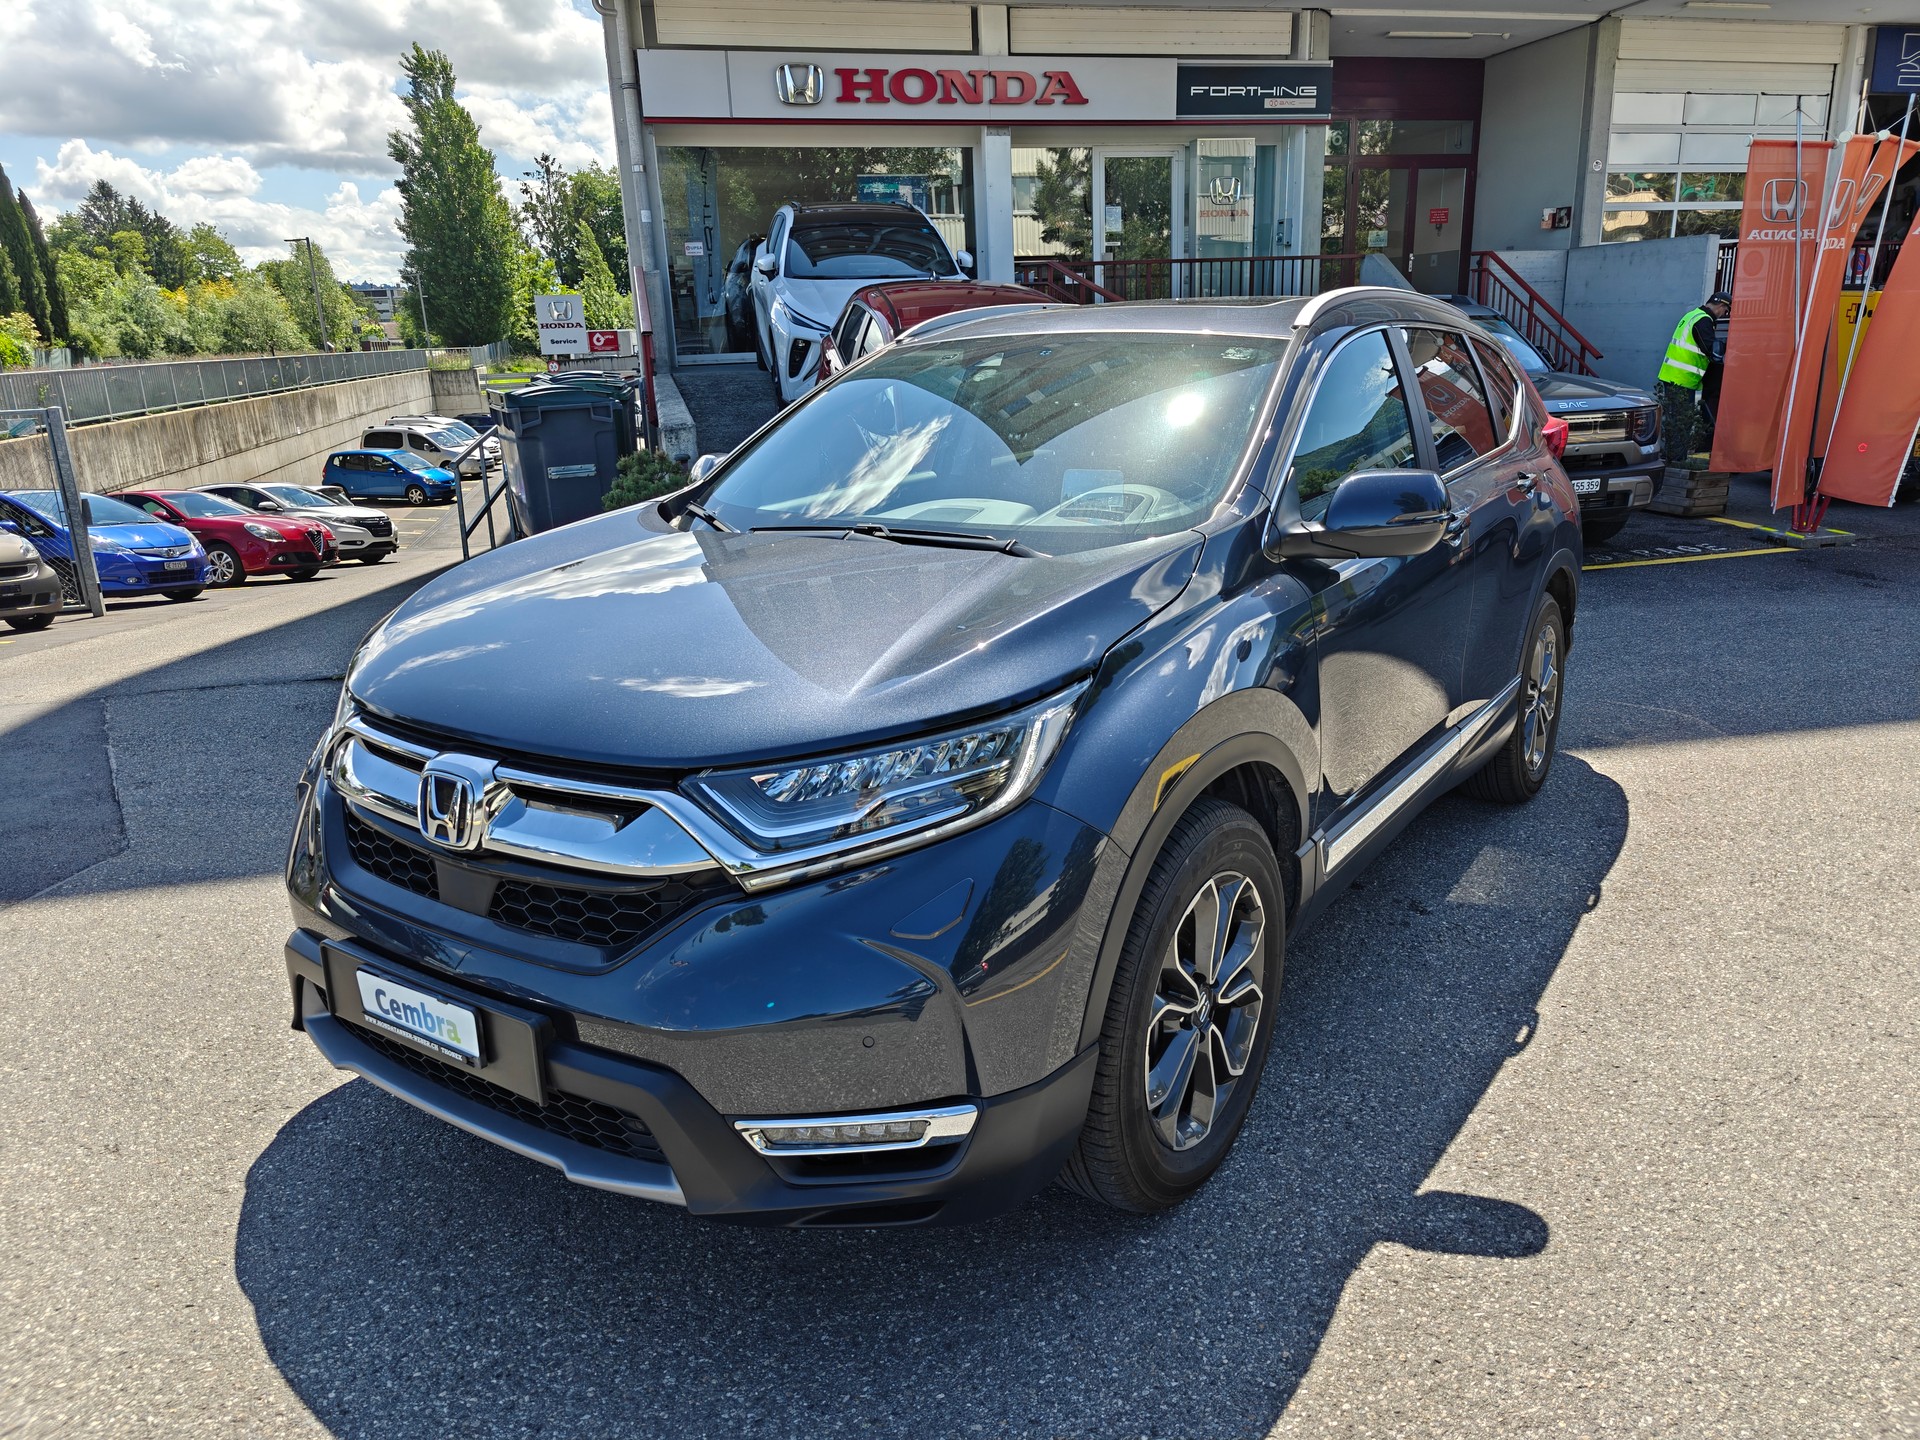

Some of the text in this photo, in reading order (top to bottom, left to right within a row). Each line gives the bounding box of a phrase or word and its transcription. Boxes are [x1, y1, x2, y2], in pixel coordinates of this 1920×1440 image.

[834, 68, 1088, 105] HONDA
[1190, 86, 1317, 96] FORTHING
[1200, 209, 1250, 217] HONDA
[1586, 480, 1600, 490] 359
[375, 988, 462, 1044] Cembra
